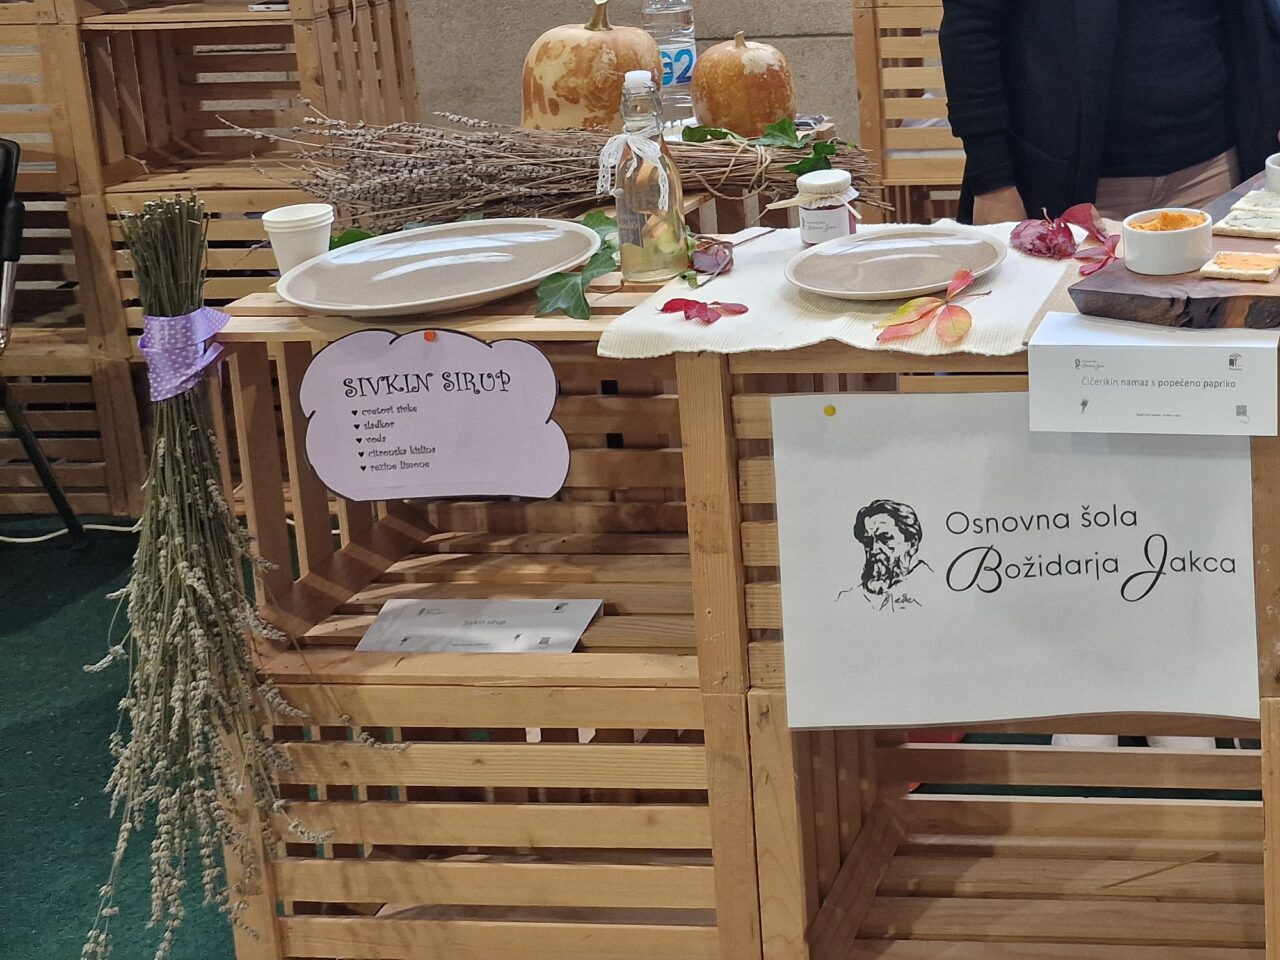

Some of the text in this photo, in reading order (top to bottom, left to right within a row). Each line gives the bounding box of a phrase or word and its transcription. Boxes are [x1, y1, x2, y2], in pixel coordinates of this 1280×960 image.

[343, 370, 511, 398] SIVKIN SIRUP
[1081, 376, 1118, 387] Čičerikin
[1158, 378, 1201, 390] popečeno
[1203, 379, 1236, 390] papriko
[362, 404, 417, 416] cvetovi sivke
[364, 420, 394, 430] sladkor
[366, 434, 386, 443] voda
[368, 445, 436, 458] citronska kislina
[400, 460, 430, 470] limone
[945, 504, 1138, 536] Osnovna šola
[945, 533, 1236, 602] Božidarja Jakca
